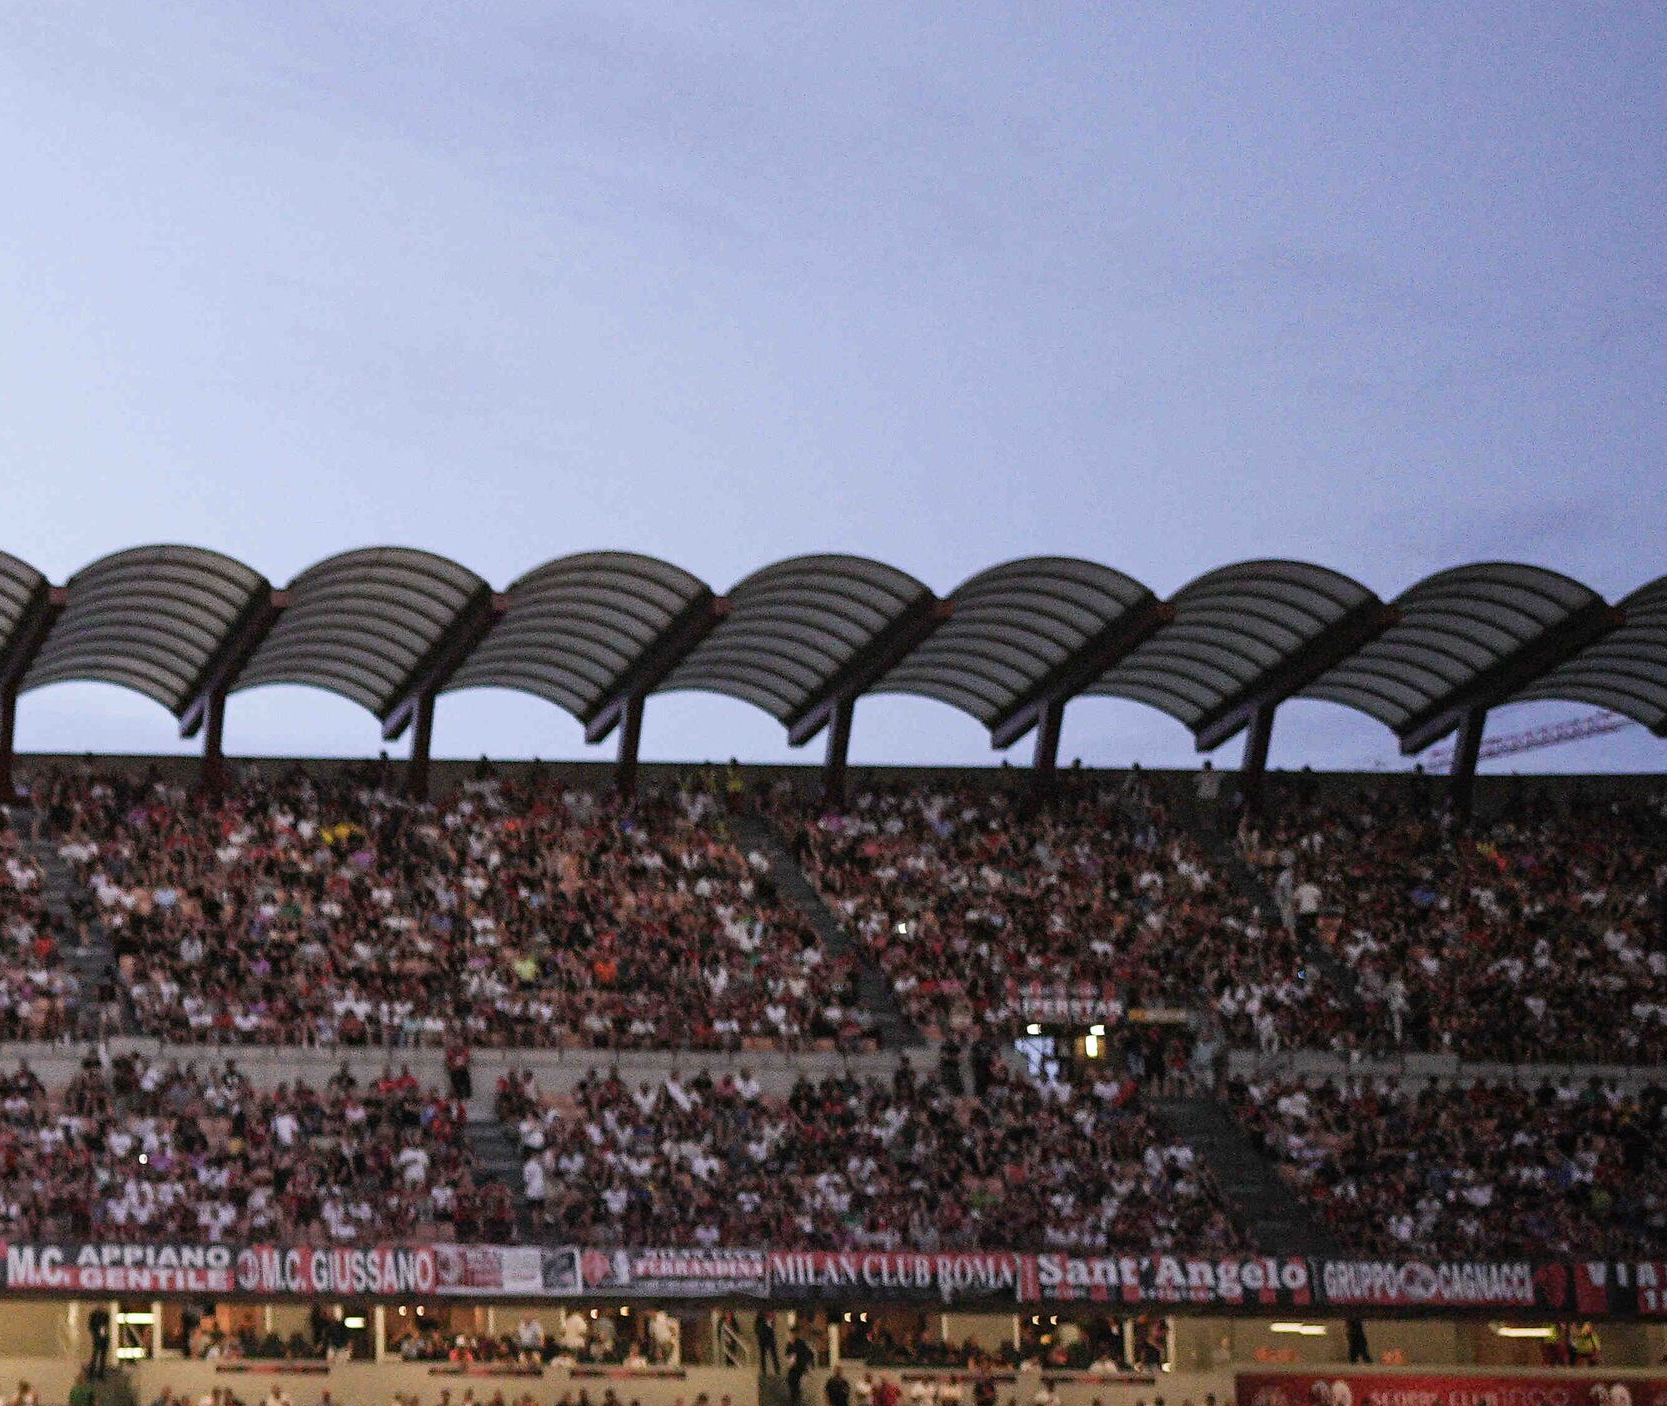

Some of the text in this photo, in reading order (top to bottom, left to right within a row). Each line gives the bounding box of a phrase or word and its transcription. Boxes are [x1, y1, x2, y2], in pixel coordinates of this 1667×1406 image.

[7, 1244, 231, 1287] M.C. APPIANO
[79, 1267, 231, 1291] GENTILE
[260, 1247, 307, 1292] M.C.
[310, 1246, 433, 1292] GIUSSANO
[772, 1253, 1013, 1288] MILAN CLUB ROMA
[1038, 1252, 1307, 1298] Sant'Angelo
[1323, 1260, 1400, 1299] GRUPPO
